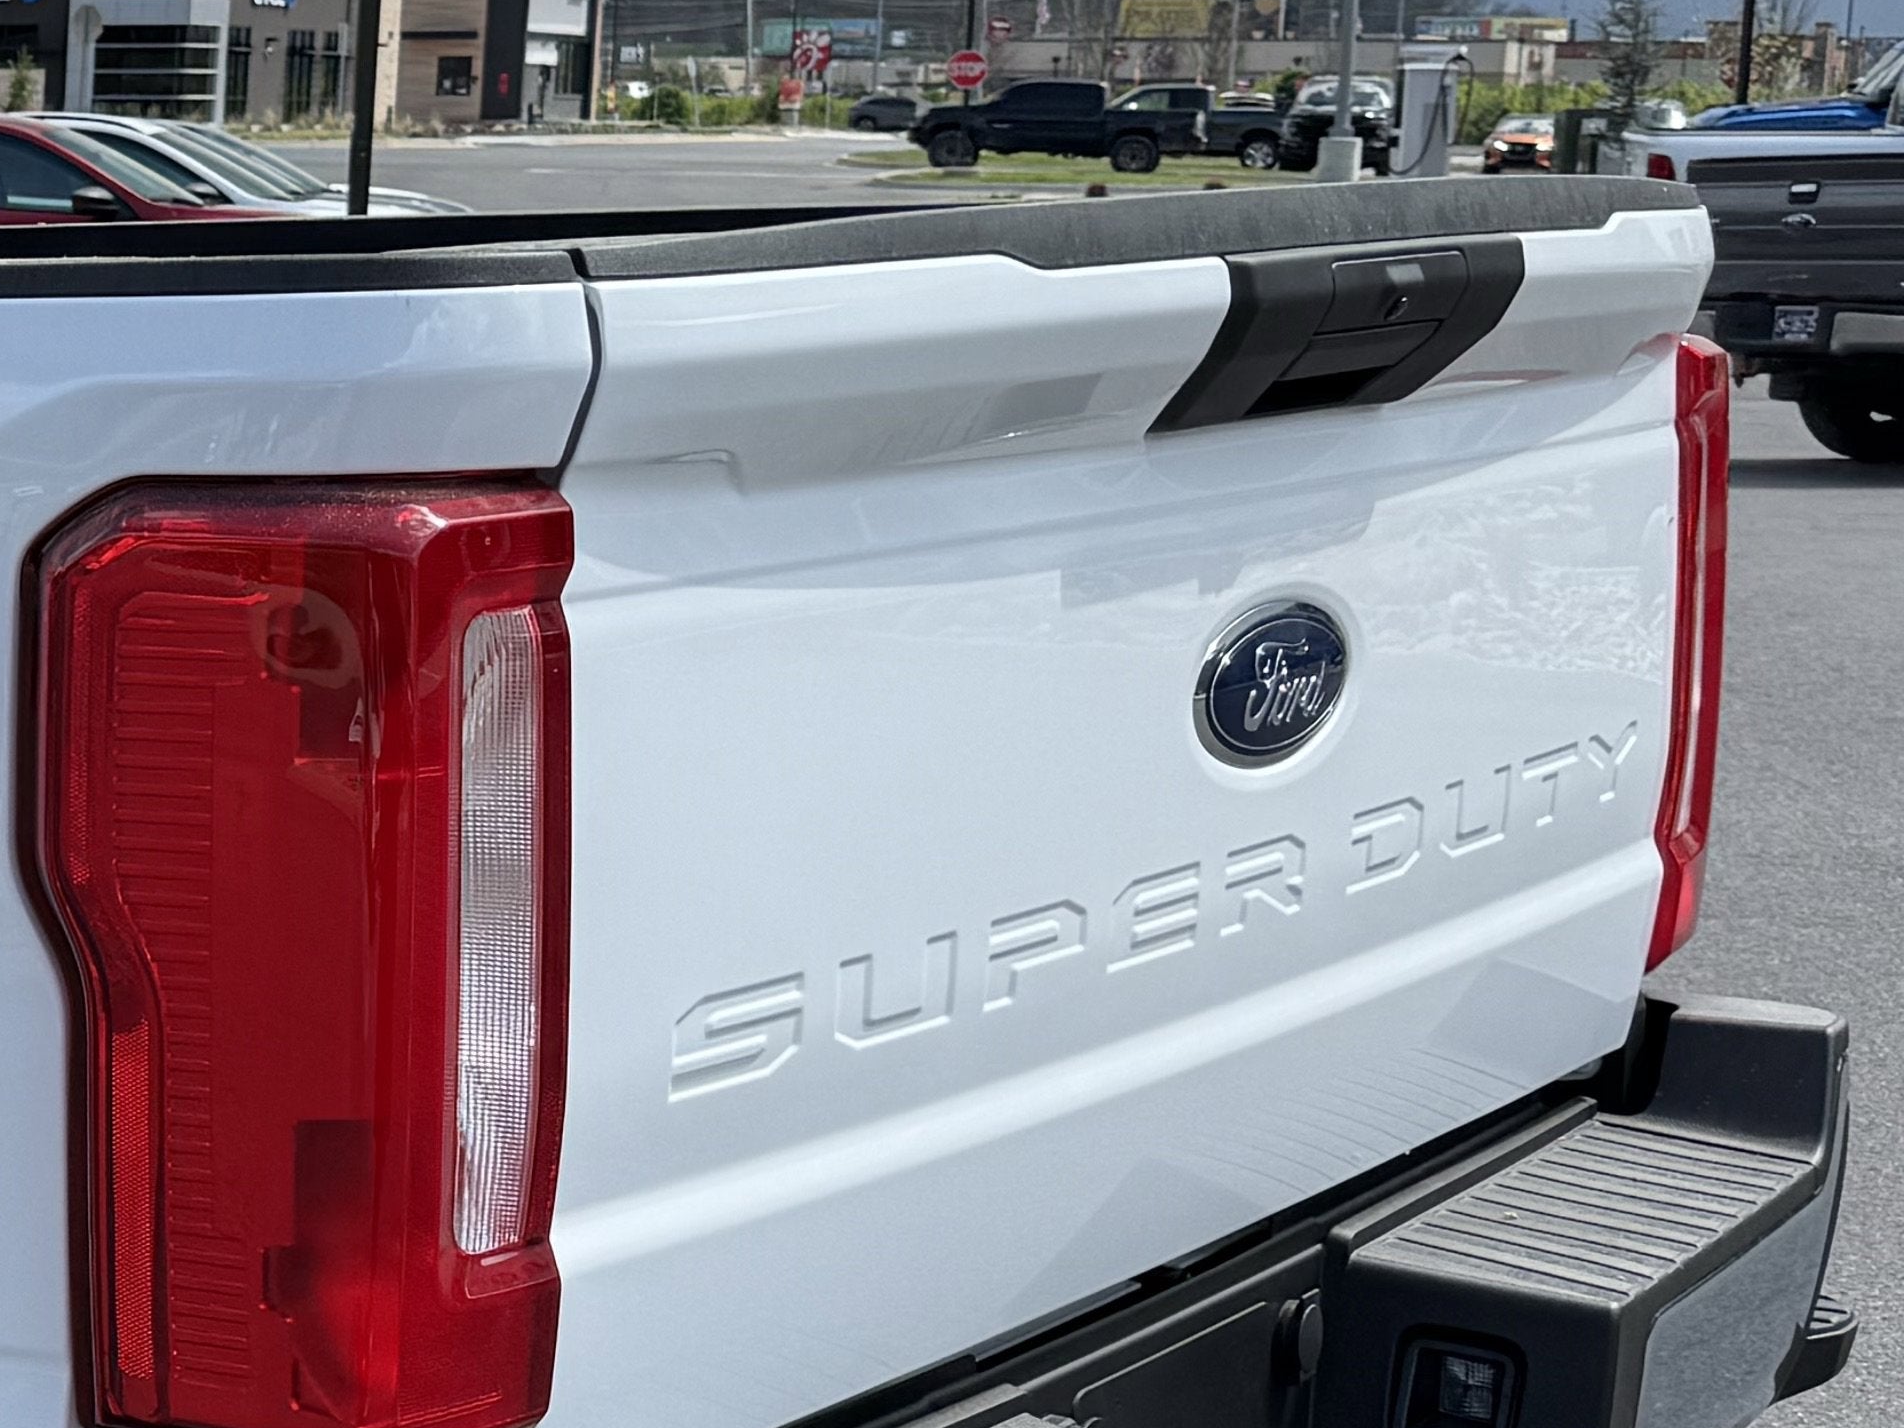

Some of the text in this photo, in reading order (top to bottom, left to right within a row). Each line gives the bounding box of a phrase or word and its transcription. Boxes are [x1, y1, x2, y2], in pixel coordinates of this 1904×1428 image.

[1244, 638, 1326, 732] Ford
[668, 719, 1638, 1104] SUPER DUTY
